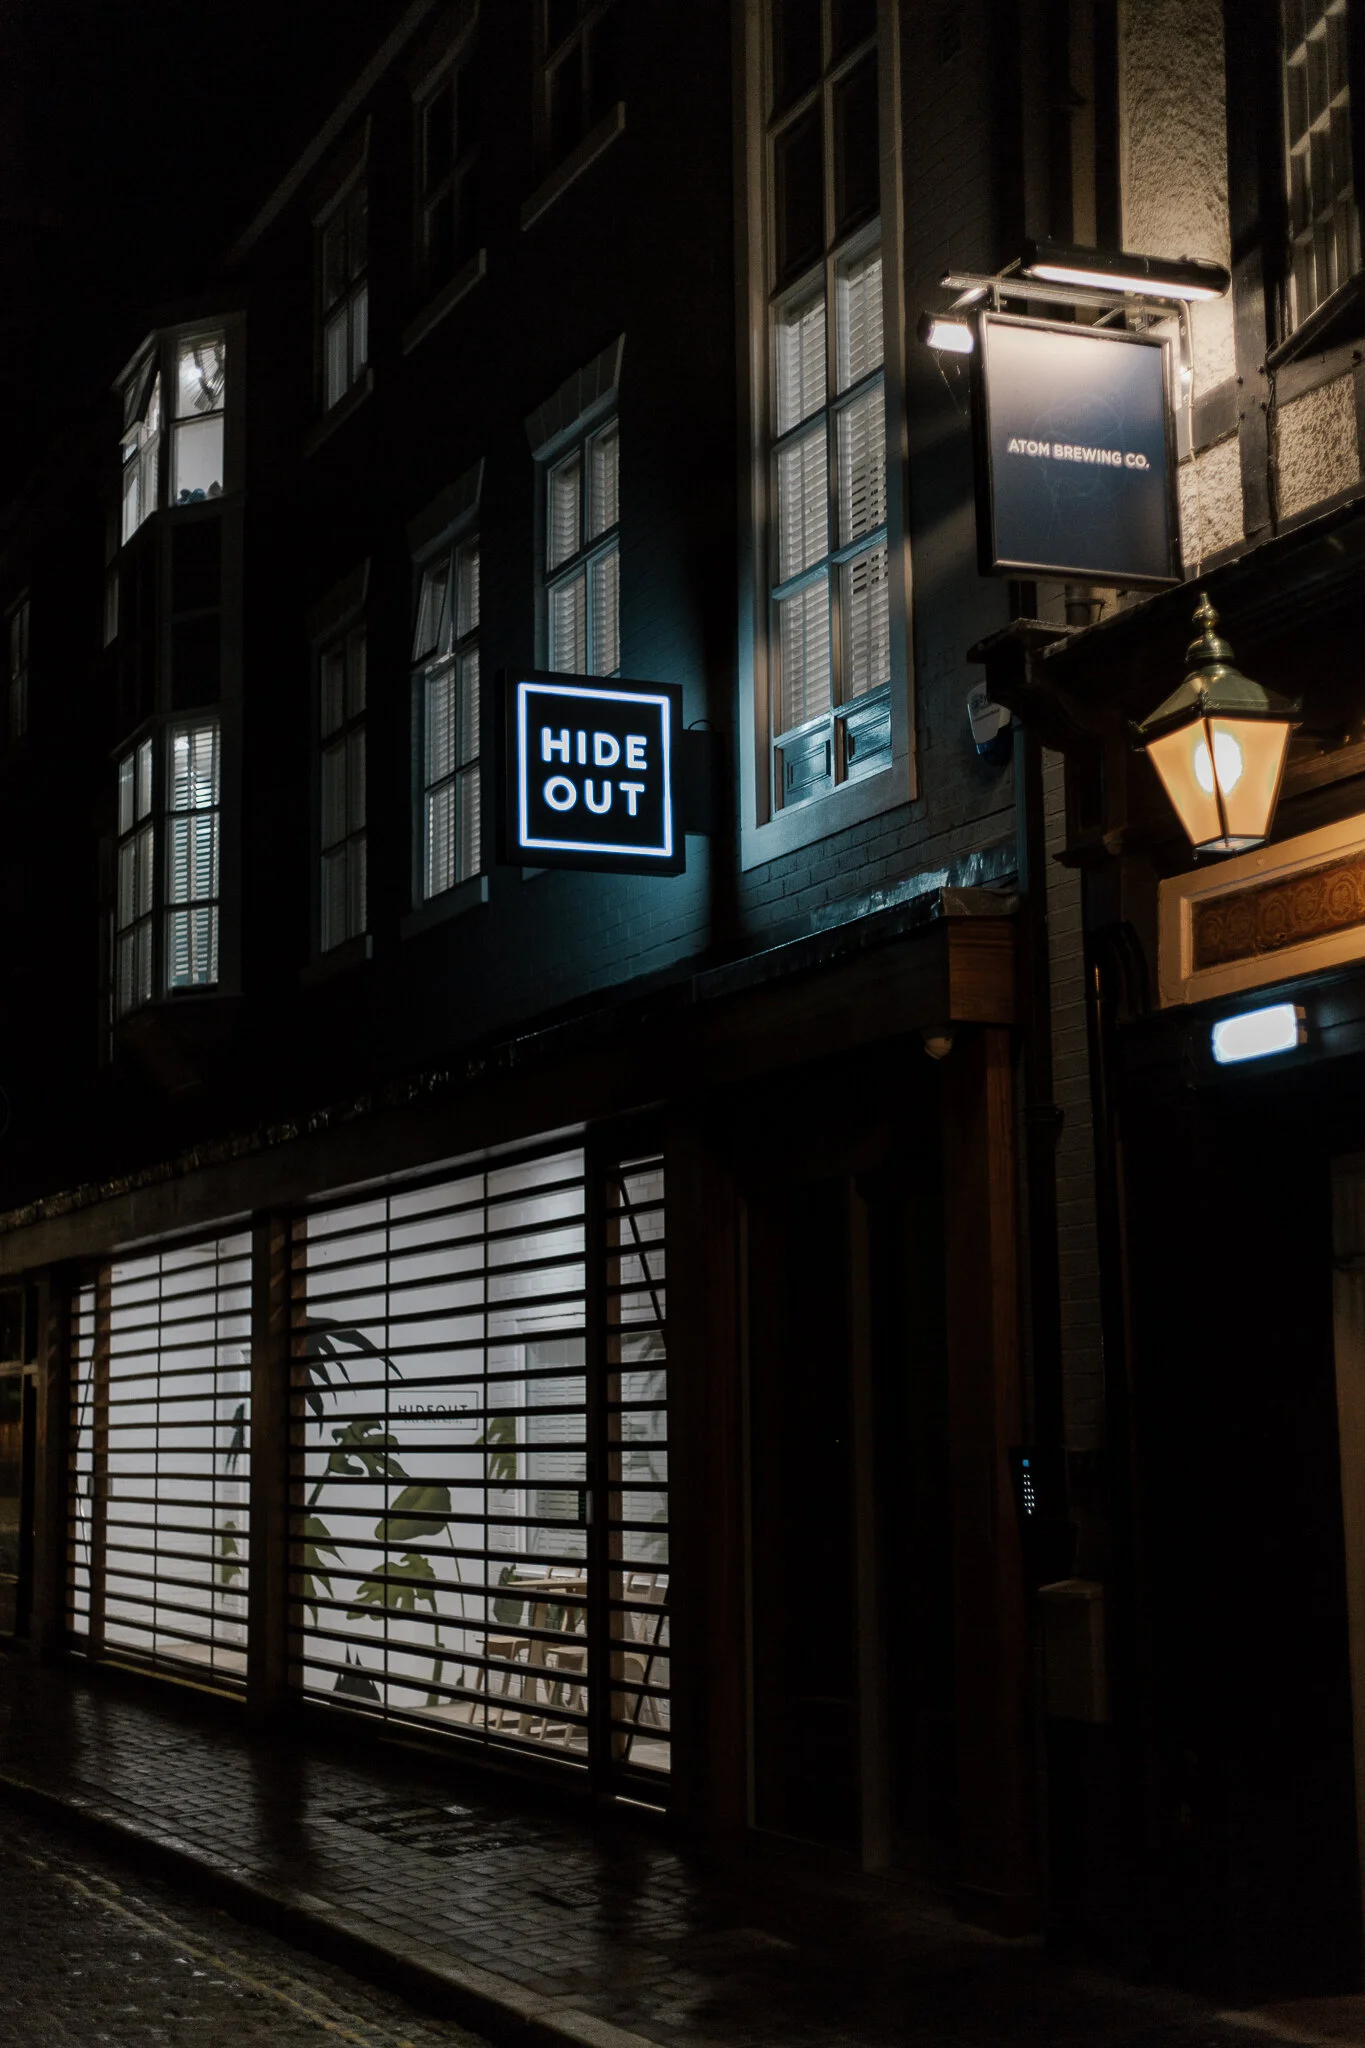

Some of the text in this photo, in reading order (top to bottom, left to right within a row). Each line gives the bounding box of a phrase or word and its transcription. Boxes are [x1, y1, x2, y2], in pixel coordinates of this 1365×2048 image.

[1008, 438, 1151, 470] ATOM BREWING CO.
[541, 726, 648, 770] HIDE
[543, 775, 646, 816] OUT
